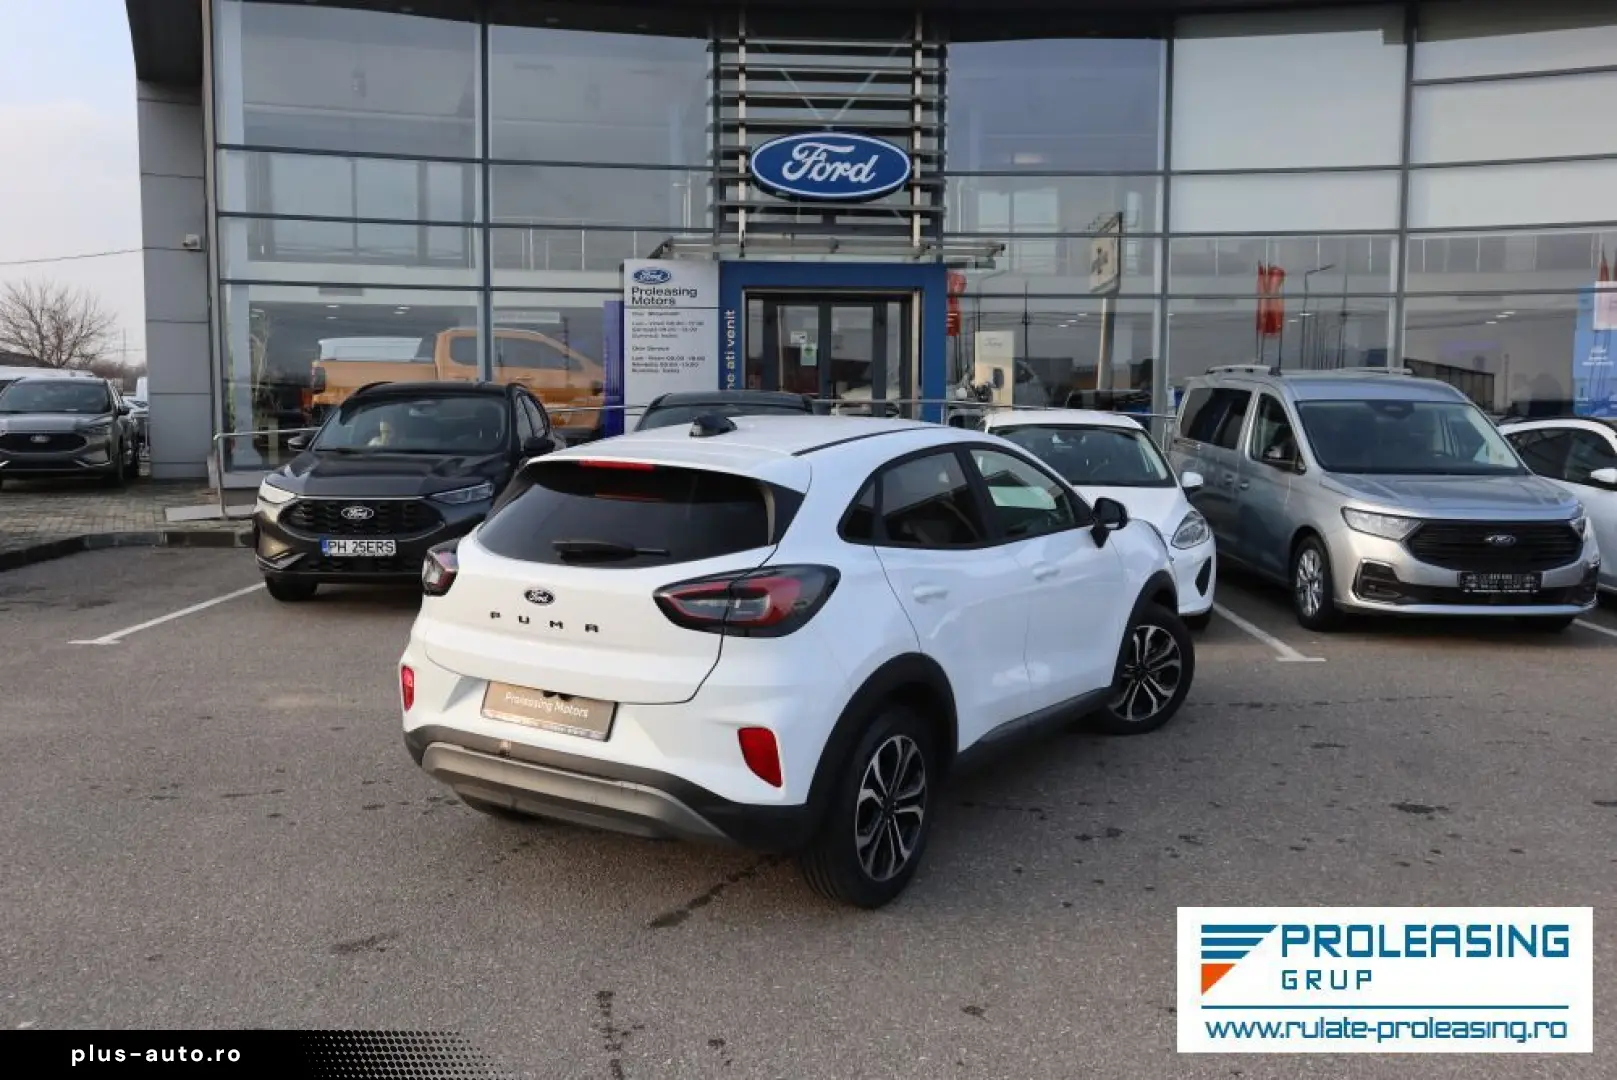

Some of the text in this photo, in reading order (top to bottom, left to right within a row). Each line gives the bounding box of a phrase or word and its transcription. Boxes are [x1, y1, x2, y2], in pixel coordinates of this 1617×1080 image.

[782, 141, 879, 183] Ford
[631, 286, 698, 298] Proleasing
[631, 295, 676, 306] Motors
[724, 309, 735, 347] venit
[724, 350, 735, 369] ati
[328, 541, 347, 554] PH
[489, 610, 599, 632] PUMA
[505, 692, 589, 719] Proleasing Motors
